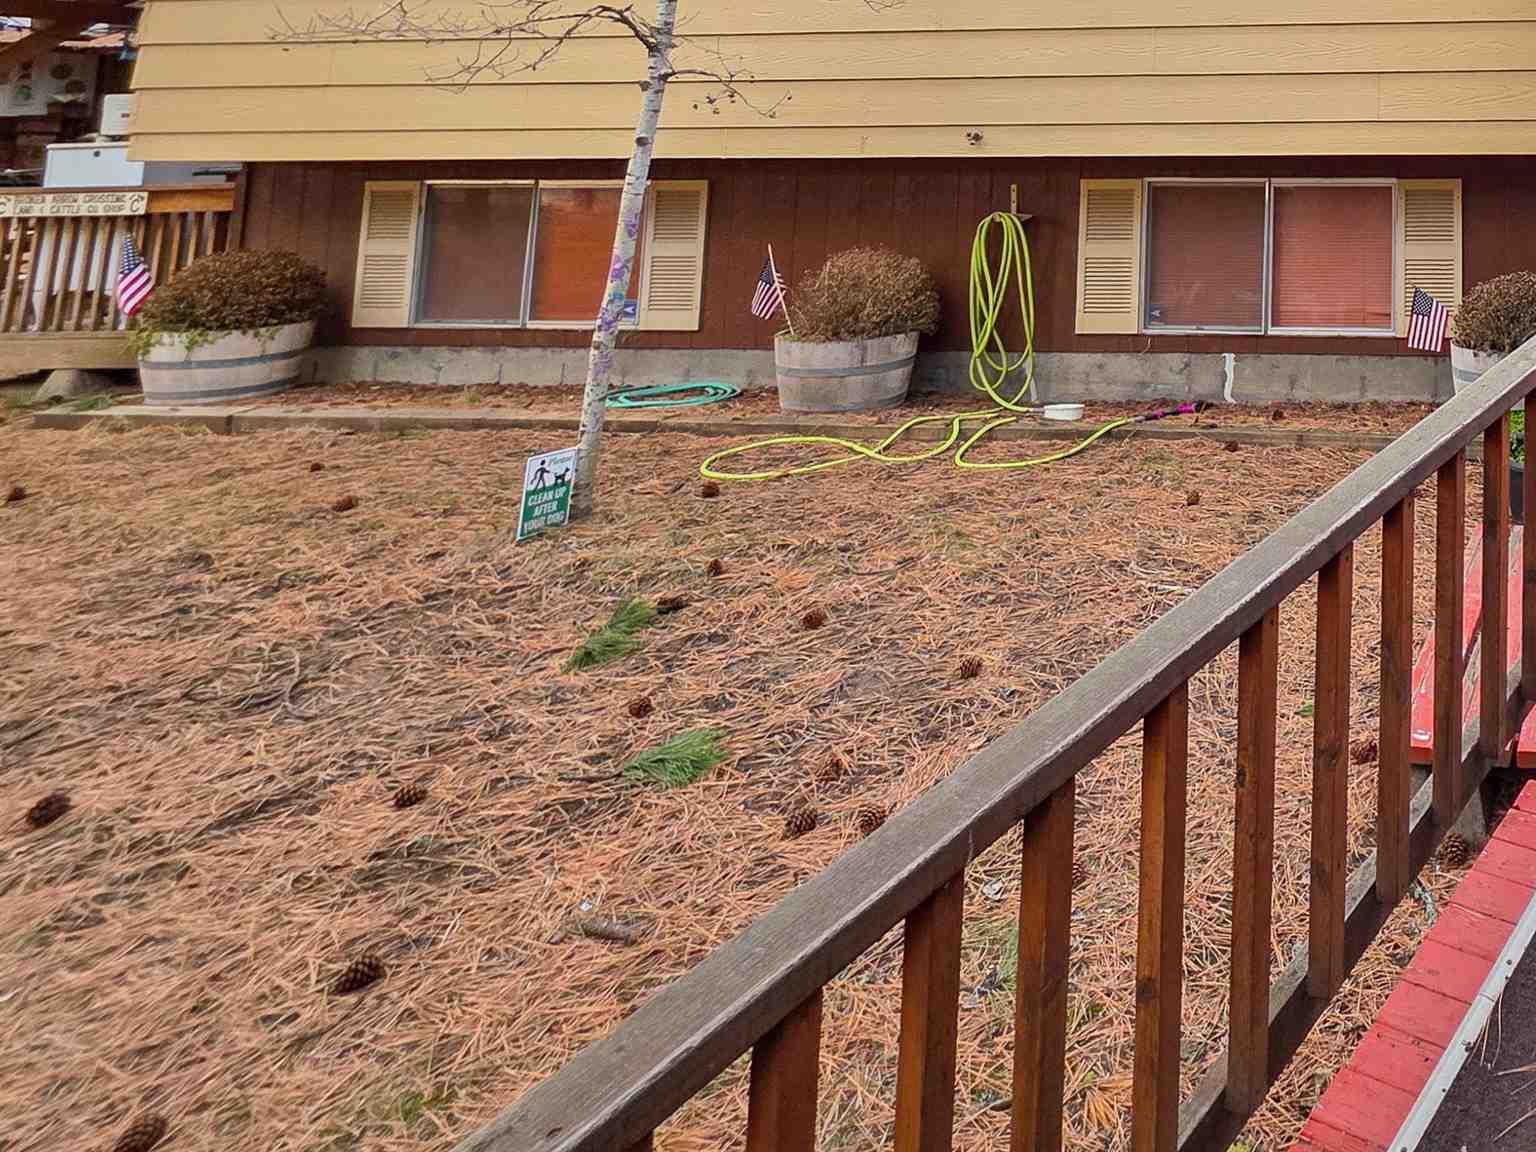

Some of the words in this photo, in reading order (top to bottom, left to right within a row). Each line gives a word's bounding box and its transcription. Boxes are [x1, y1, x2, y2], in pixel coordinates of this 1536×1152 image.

[528, 490, 554, 506] CLEAN
[554, 486, 568, 500] UP
[533, 501, 558, 517] AFTER
[523, 516, 546, 533] YOUR
[547, 510, 565, 525] DOG
